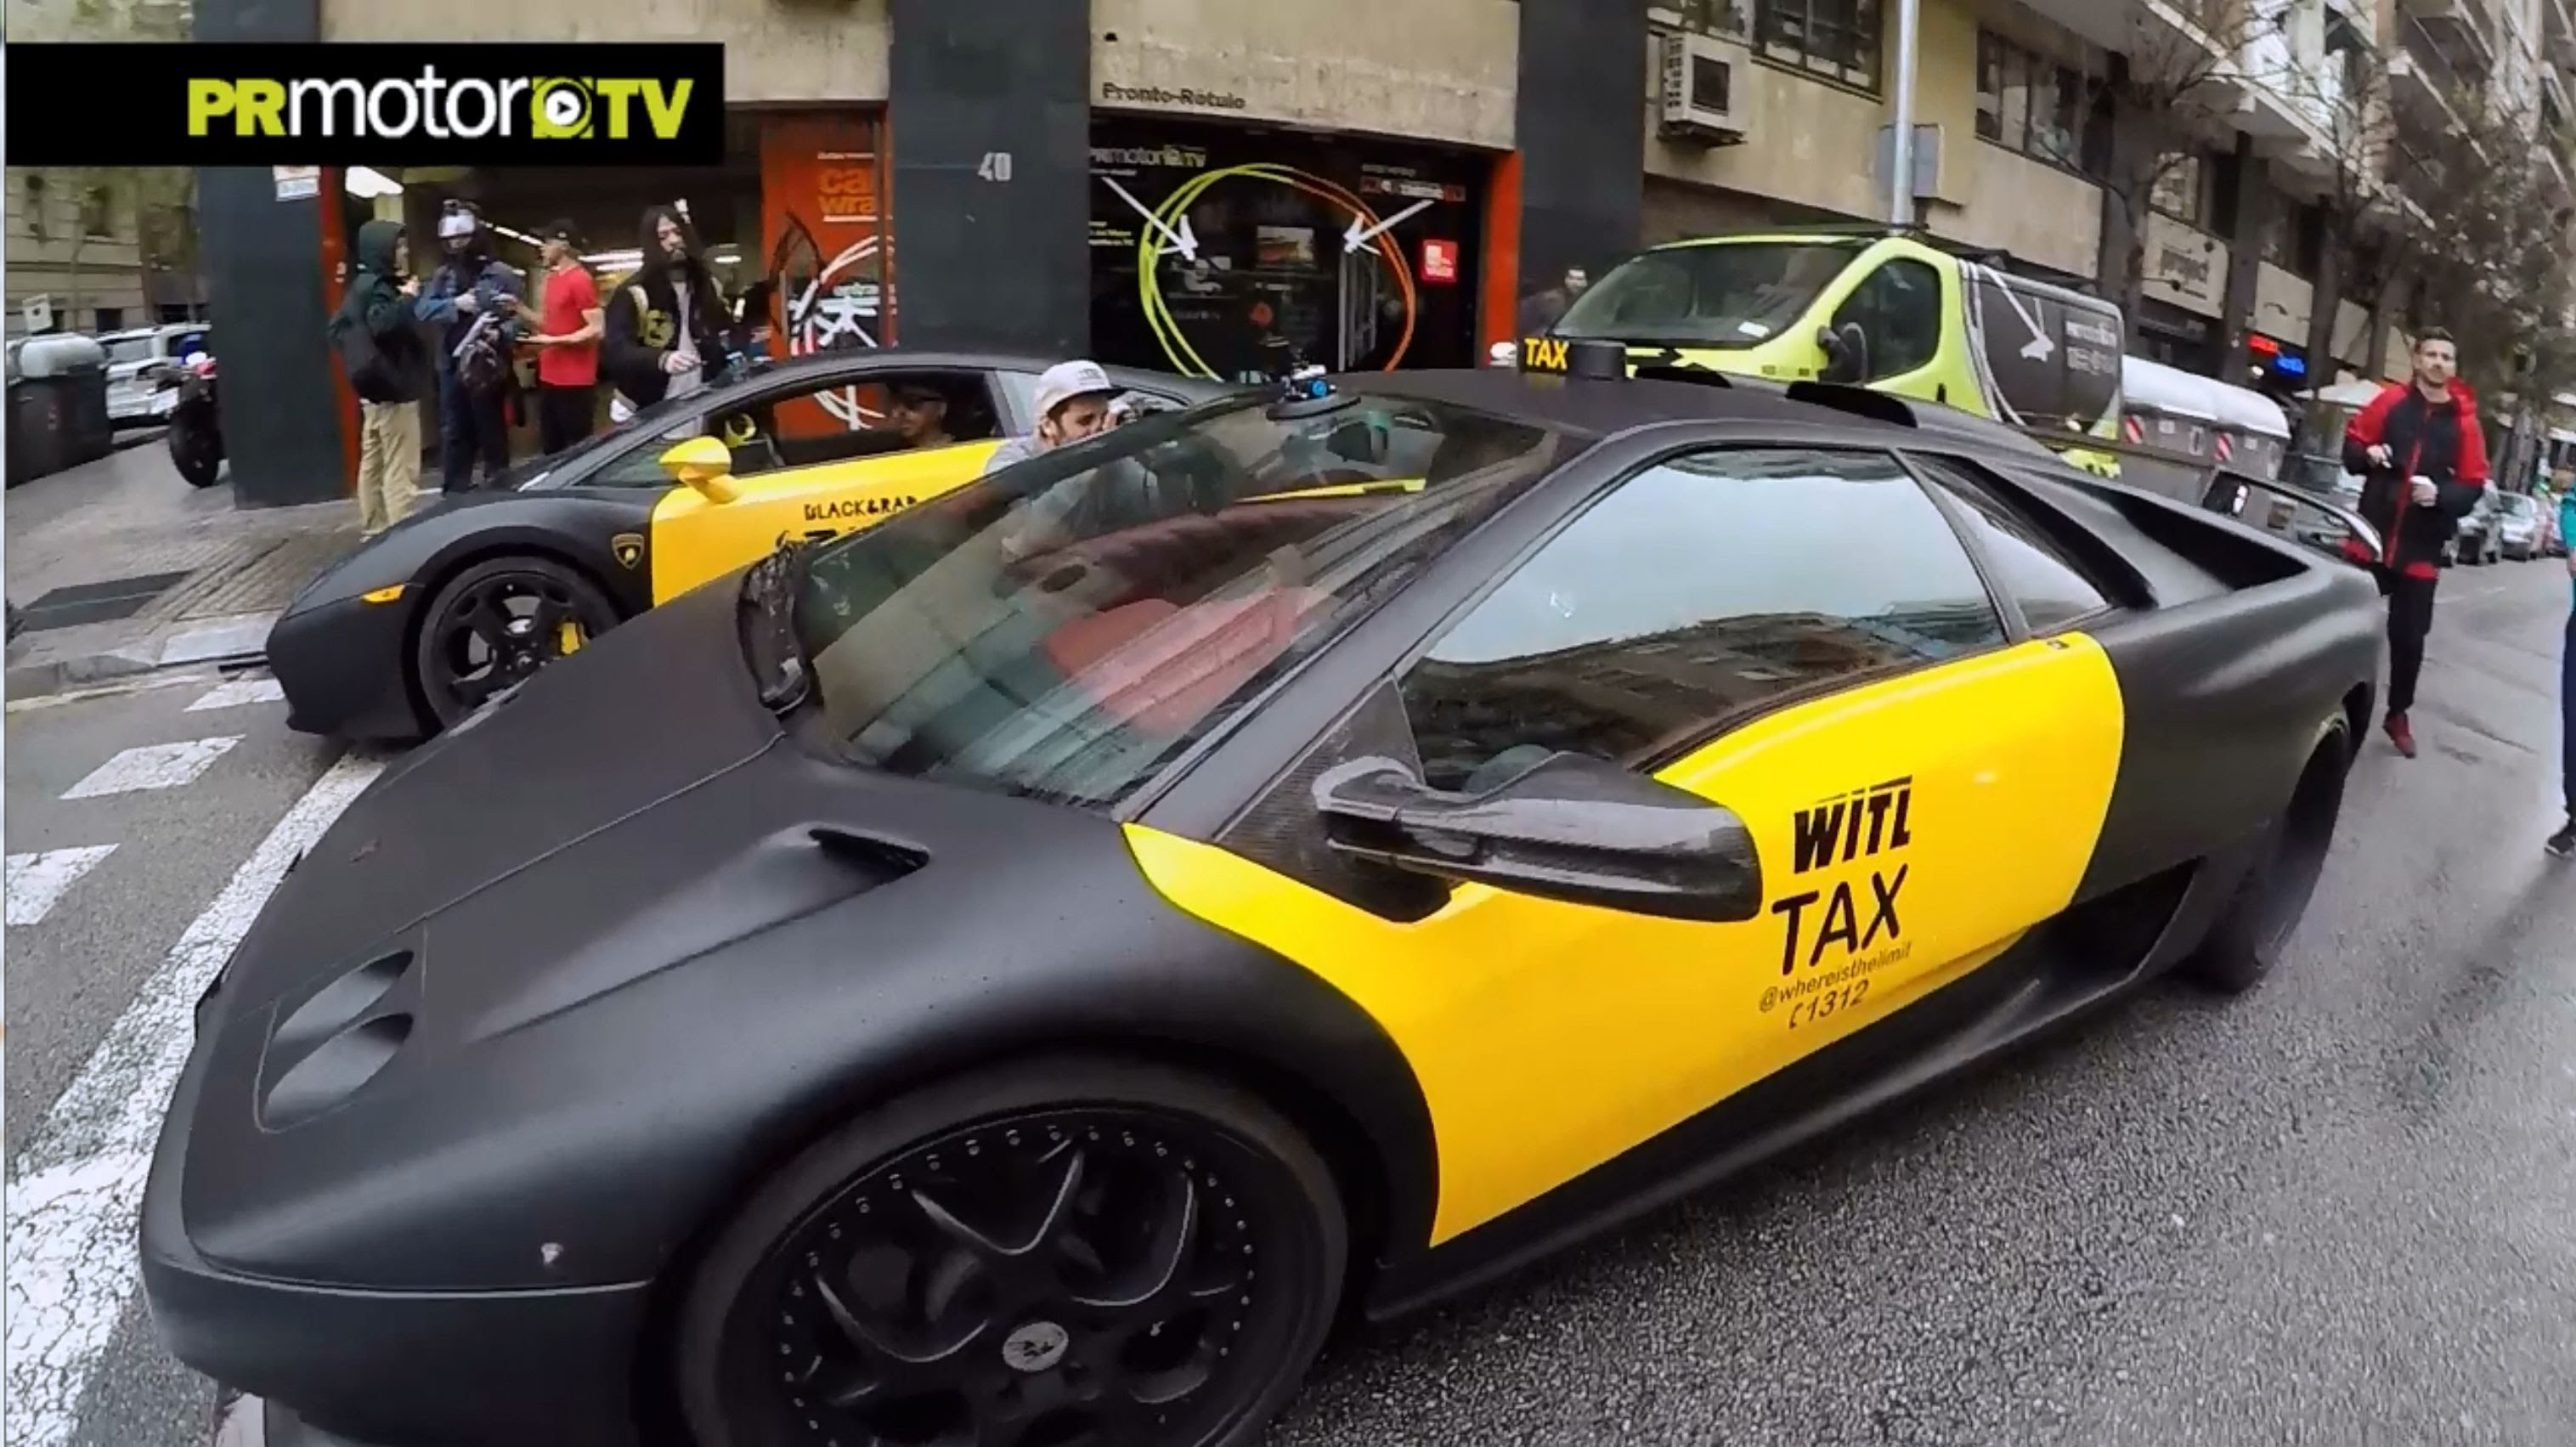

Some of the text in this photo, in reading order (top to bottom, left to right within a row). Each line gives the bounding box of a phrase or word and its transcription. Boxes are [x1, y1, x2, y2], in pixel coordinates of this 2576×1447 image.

[978, 151, 1012, 182] 40
[1524, 337, 1569, 370] TAX
[1771, 863, 1908, 976] TAX
